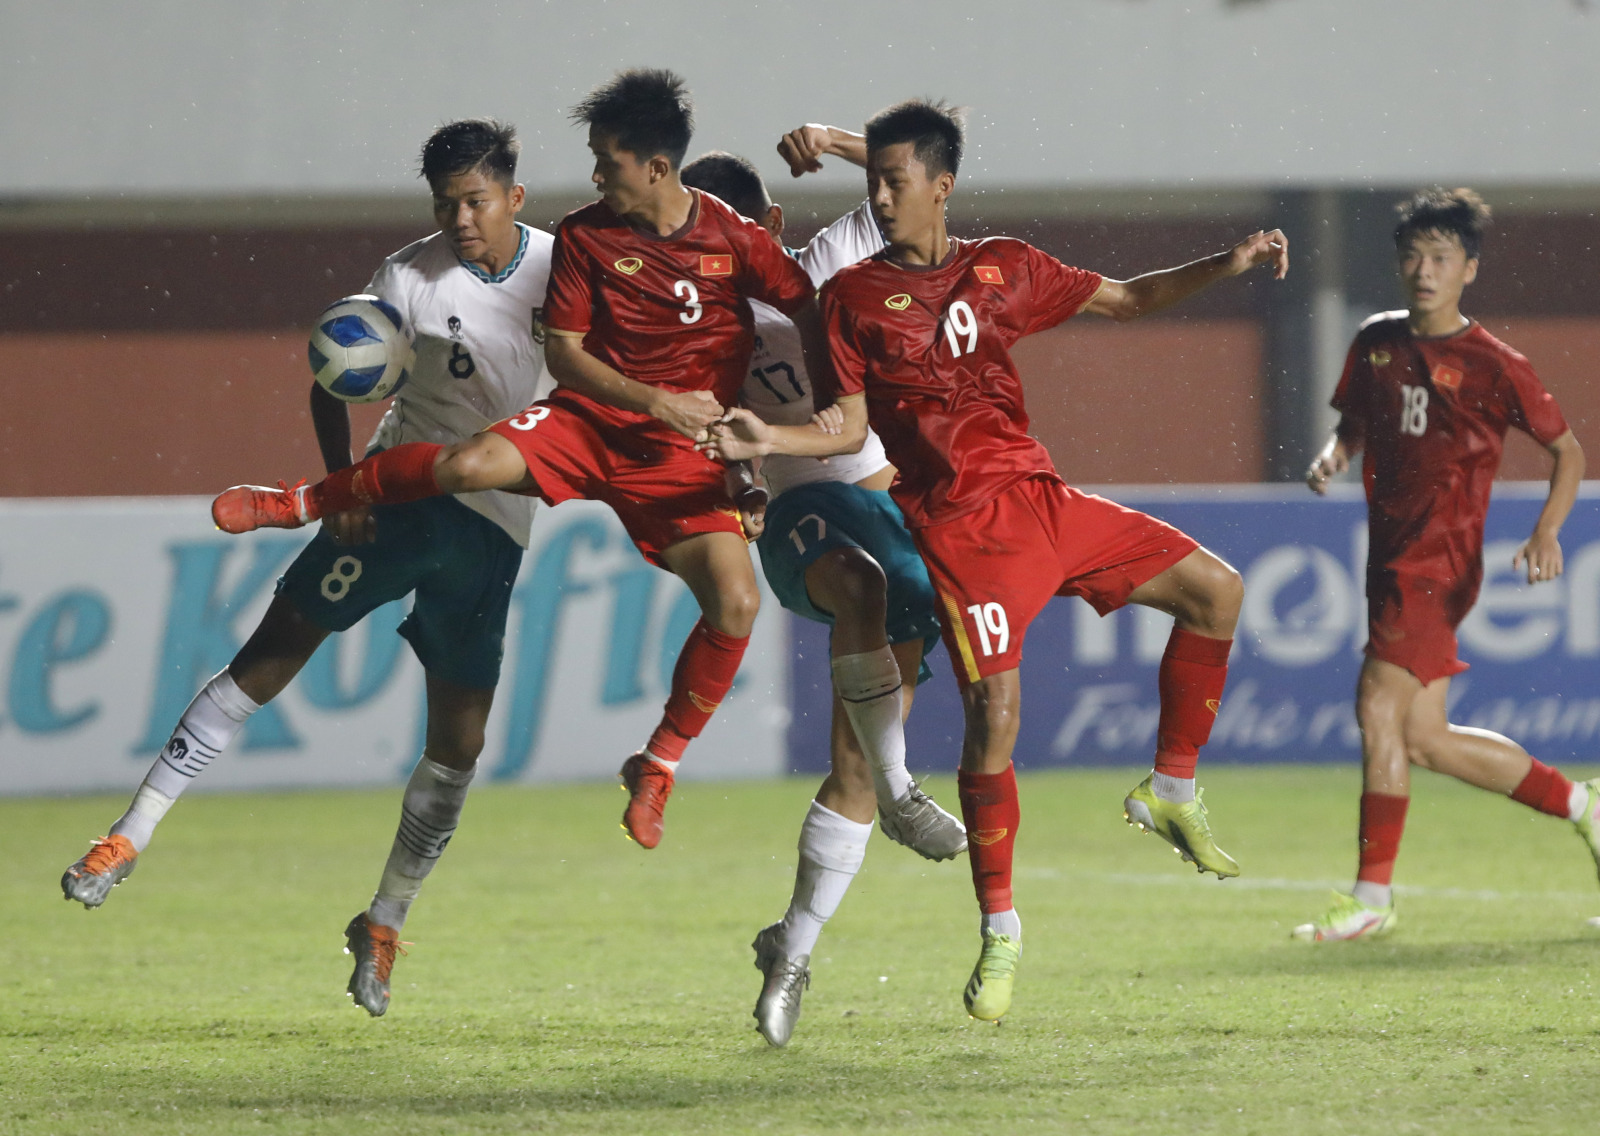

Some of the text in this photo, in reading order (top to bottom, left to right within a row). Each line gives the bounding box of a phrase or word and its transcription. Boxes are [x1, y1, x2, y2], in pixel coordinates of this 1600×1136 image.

[673, 279, 703, 325] 3
[939, 300, 978, 359] 19
[751, 360, 807, 405] 17
[508, 405, 551, 431] 3
[1401, 384, 1429, 437] 18
[788, 513, 827, 556] 17
[320, 555, 363, 602] 8
[966, 601, 1010, 657] 19
